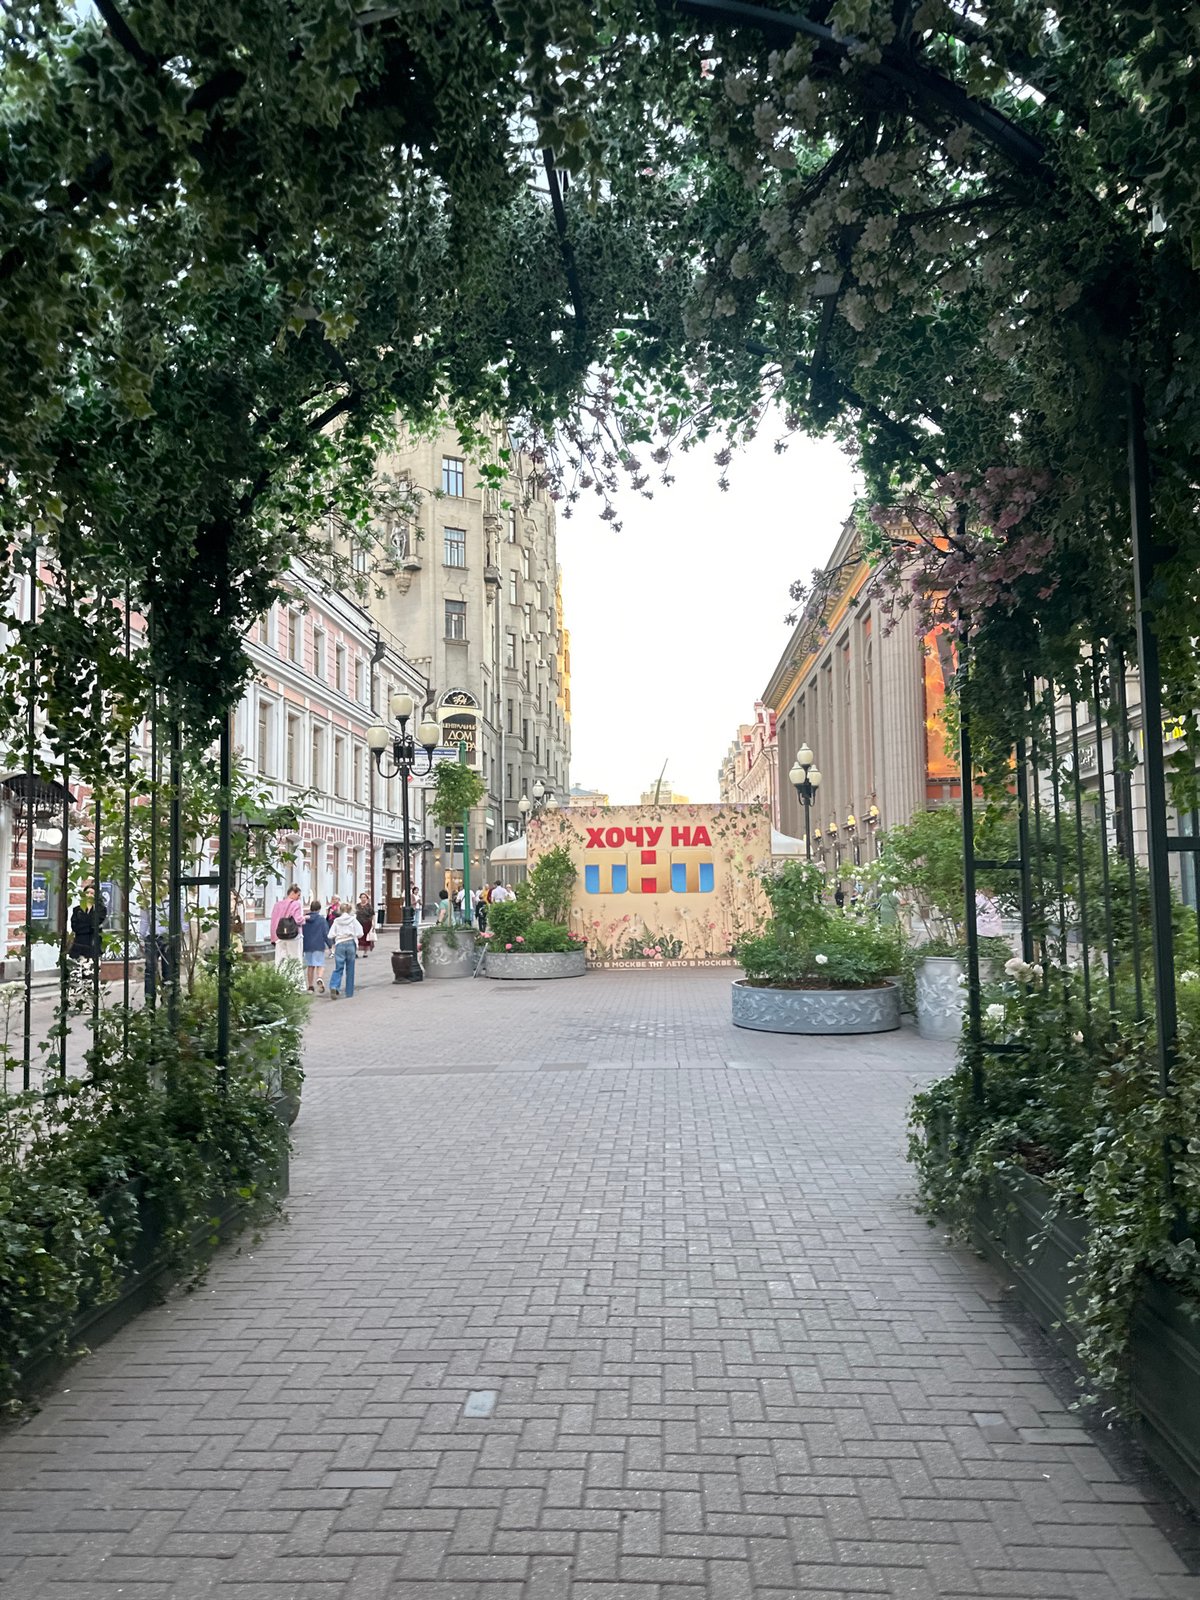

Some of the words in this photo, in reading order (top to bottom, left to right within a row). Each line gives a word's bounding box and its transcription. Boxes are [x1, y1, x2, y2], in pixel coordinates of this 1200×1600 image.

[448, 730, 472, 740] ДОМ
[443, 740, 477, 752] АКТРА
[585, 826, 664, 848] ХОЧУ
[671, 826, 712, 847] НА
[584, 849, 715, 894] ТНТ
[648, 960, 664, 968] ТНТ
[697, 959, 732, 967] МОСКВЕ
